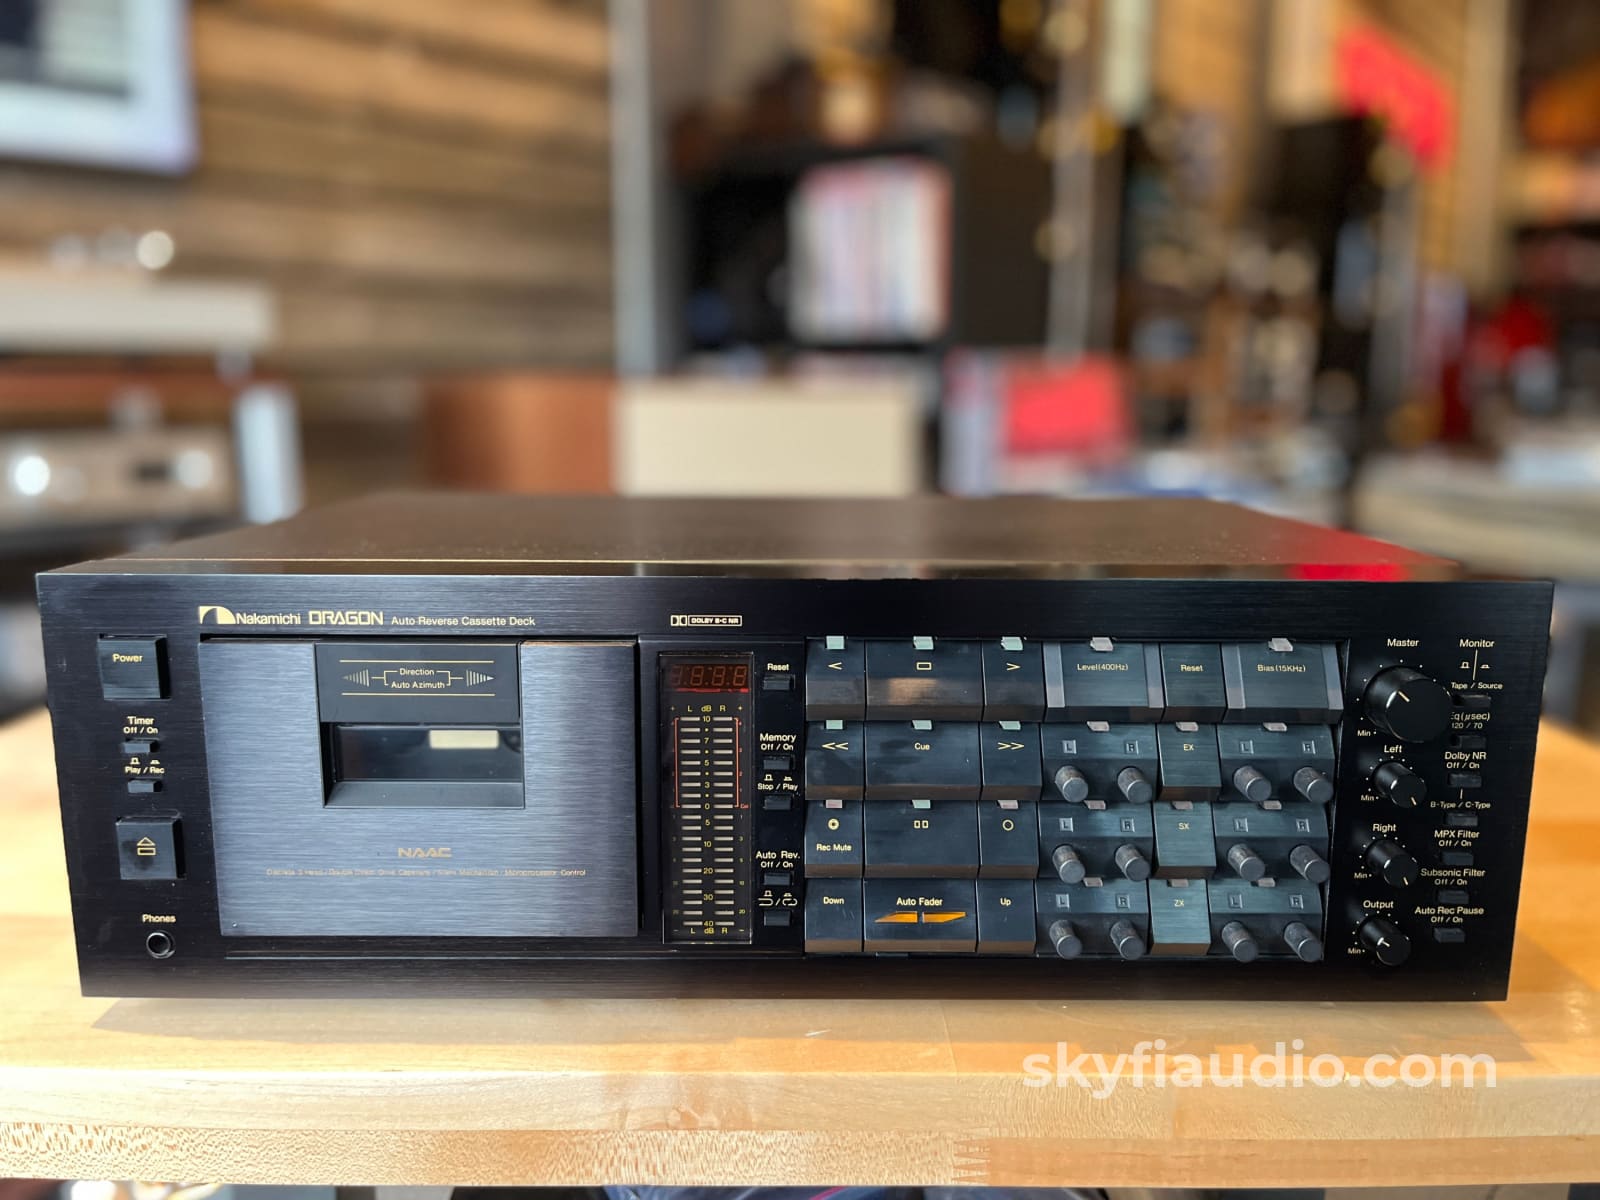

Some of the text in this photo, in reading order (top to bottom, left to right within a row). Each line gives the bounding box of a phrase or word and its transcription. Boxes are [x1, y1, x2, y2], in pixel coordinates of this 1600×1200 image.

[237, 611, 536, 626] Nakamichi DRAGON Auto Reverse Cassette Deck
[1387, 638, 1419, 647] Master
[1460, 638, 1494, 648] Monitor
[112, 654, 142, 662] Power
[767, 663, 789, 671] Reset
[1181, 664, 1203, 672] Reset
[400, 668, 434, 676] Direction
[391, 681, 445, 689] Auto Azimuth
[1451, 682, 1468, 690] Tape
[1478, 682, 1503, 690] Source
[127, 716, 154, 725] Timer
[123, 726, 137, 734] Off
[146, 726, 158, 734] On
[760, 733, 796, 743] Memory
[761, 743, 774, 751] Off
[783, 743, 794, 751] On
[914, 742, 930, 750] Cue
[1183, 743, 1194, 751] EX
[1384, 745, 1402, 753] Left
[1445, 752, 1487, 761] Dolby NR
[125, 766, 141, 775] Play
[150, 766, 165, 775] Rec
[758, 783, 774, 791] Stop
[782, 783, 798, 791] Play
[1430, 801, 1456, 809] B-Type
[1465, 801, 1491, 809] C-Type
[1178, 822, 1190, 830] SX
[1372, 823, 1396, 832] Right
[1434, 830, 1480, 838] MPX Filter
[816, 843, 852, 851] Rec Mute
[398, 848, 451, 858] NAAC
[756, 851, 800, 859] Auto Rev.
[1421, 868, 1486, 876] Subsonic Filter
[897, 898, 943, 906] Auto Fader
[1000, 898, 1011, 906] Up
[1174, 899, 1185, 907] ZX
[1363, 900, 1394, 909] Output
[1414, 906, 1484, 914] Auto Rec Pause
[142, 914, 176, 923] Phones
